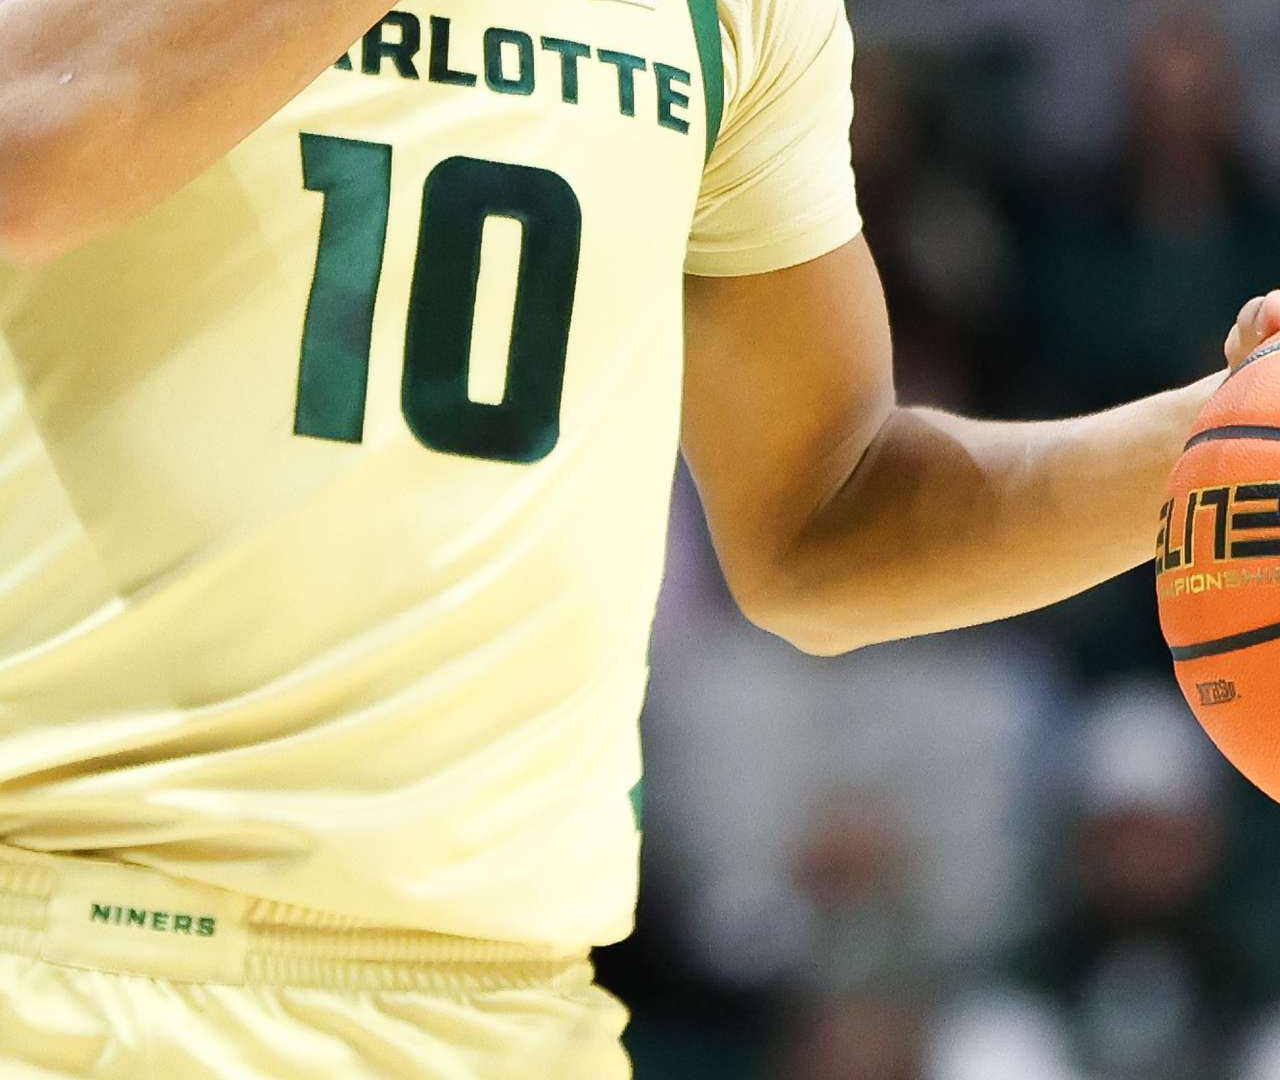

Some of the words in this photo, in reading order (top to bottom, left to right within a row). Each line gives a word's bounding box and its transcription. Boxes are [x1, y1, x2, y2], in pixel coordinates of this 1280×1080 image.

[333, 10, 692, 135] RLOTTE
[293, 131, 583, 464] 10
[91, 903, 216, 938] NINERS
